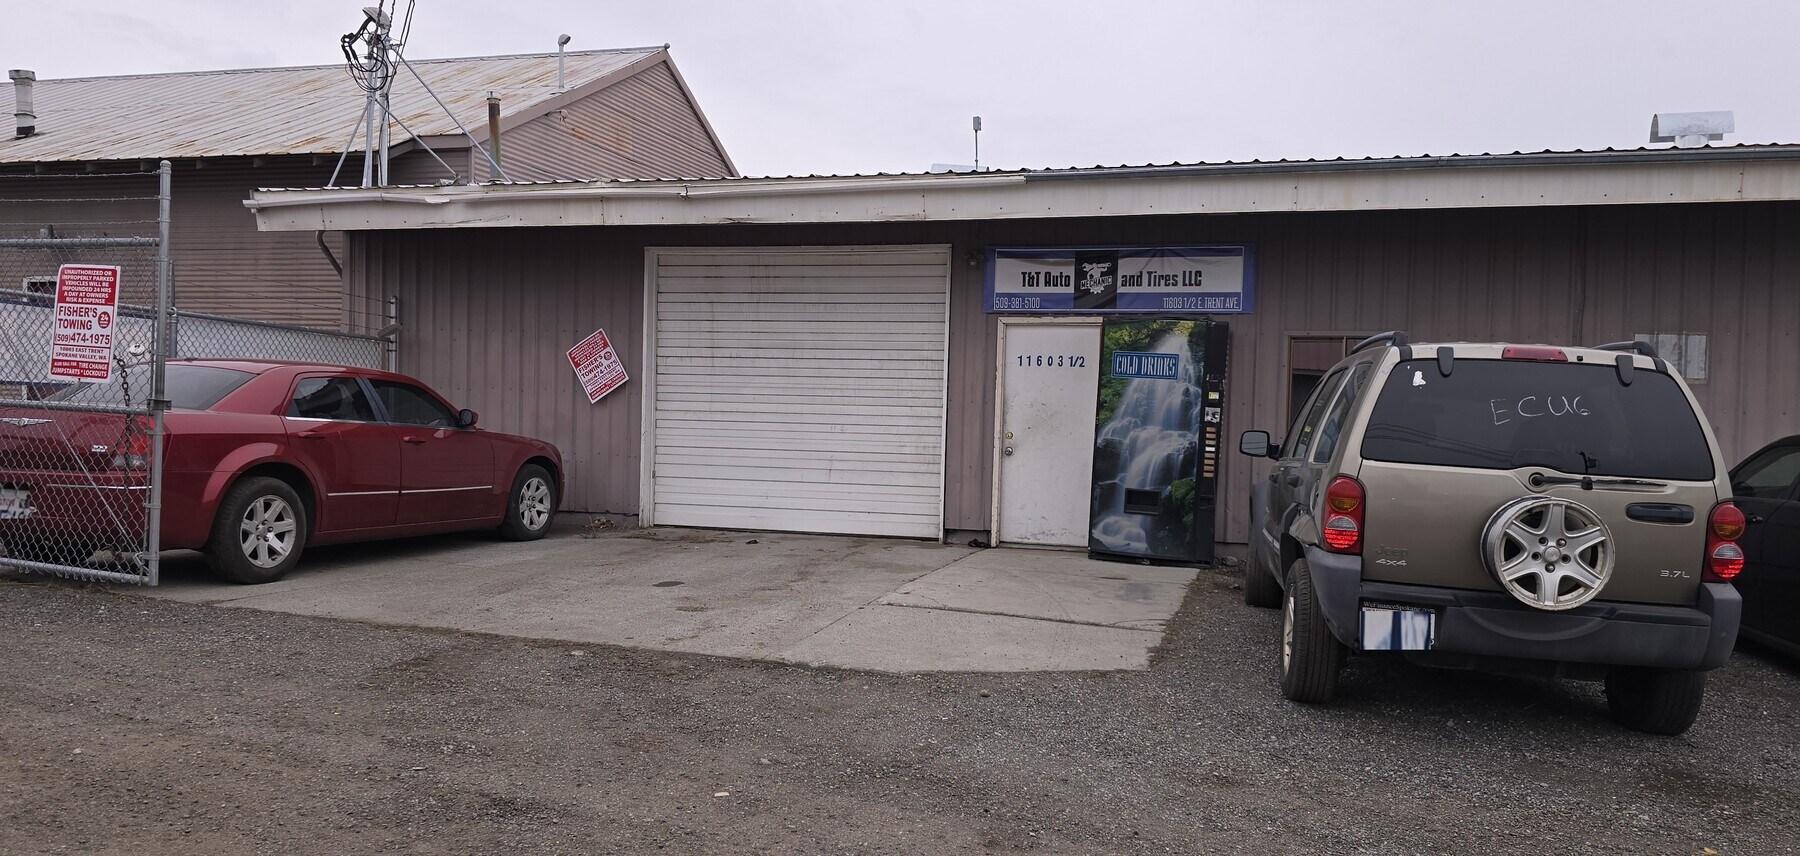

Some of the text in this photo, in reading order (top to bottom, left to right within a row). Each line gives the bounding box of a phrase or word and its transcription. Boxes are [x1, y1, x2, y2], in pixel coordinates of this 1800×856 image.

[1021, 272, 1071, 287] T&T Auto
[1081, 276, 1112, 289] MECHANIC
[1121, 270, 1202, 287] and Tires LLC
[996, 297, 1040, 308] 509-381-5100
[1163, 297, 1182, 308] 11603
[1184, 298, 1196, 308] 1/2
[1204, 297, 1224, 308] TRENT
[59, 306, 98, 318] FISHER'S
[58, 319, 92, 330] TOWING
[580, 360, 603, 379] TOWING
[1116, 356, 1176, 376] COLD DRINKS
[1660, 570, 1690, 578] 3.7L
